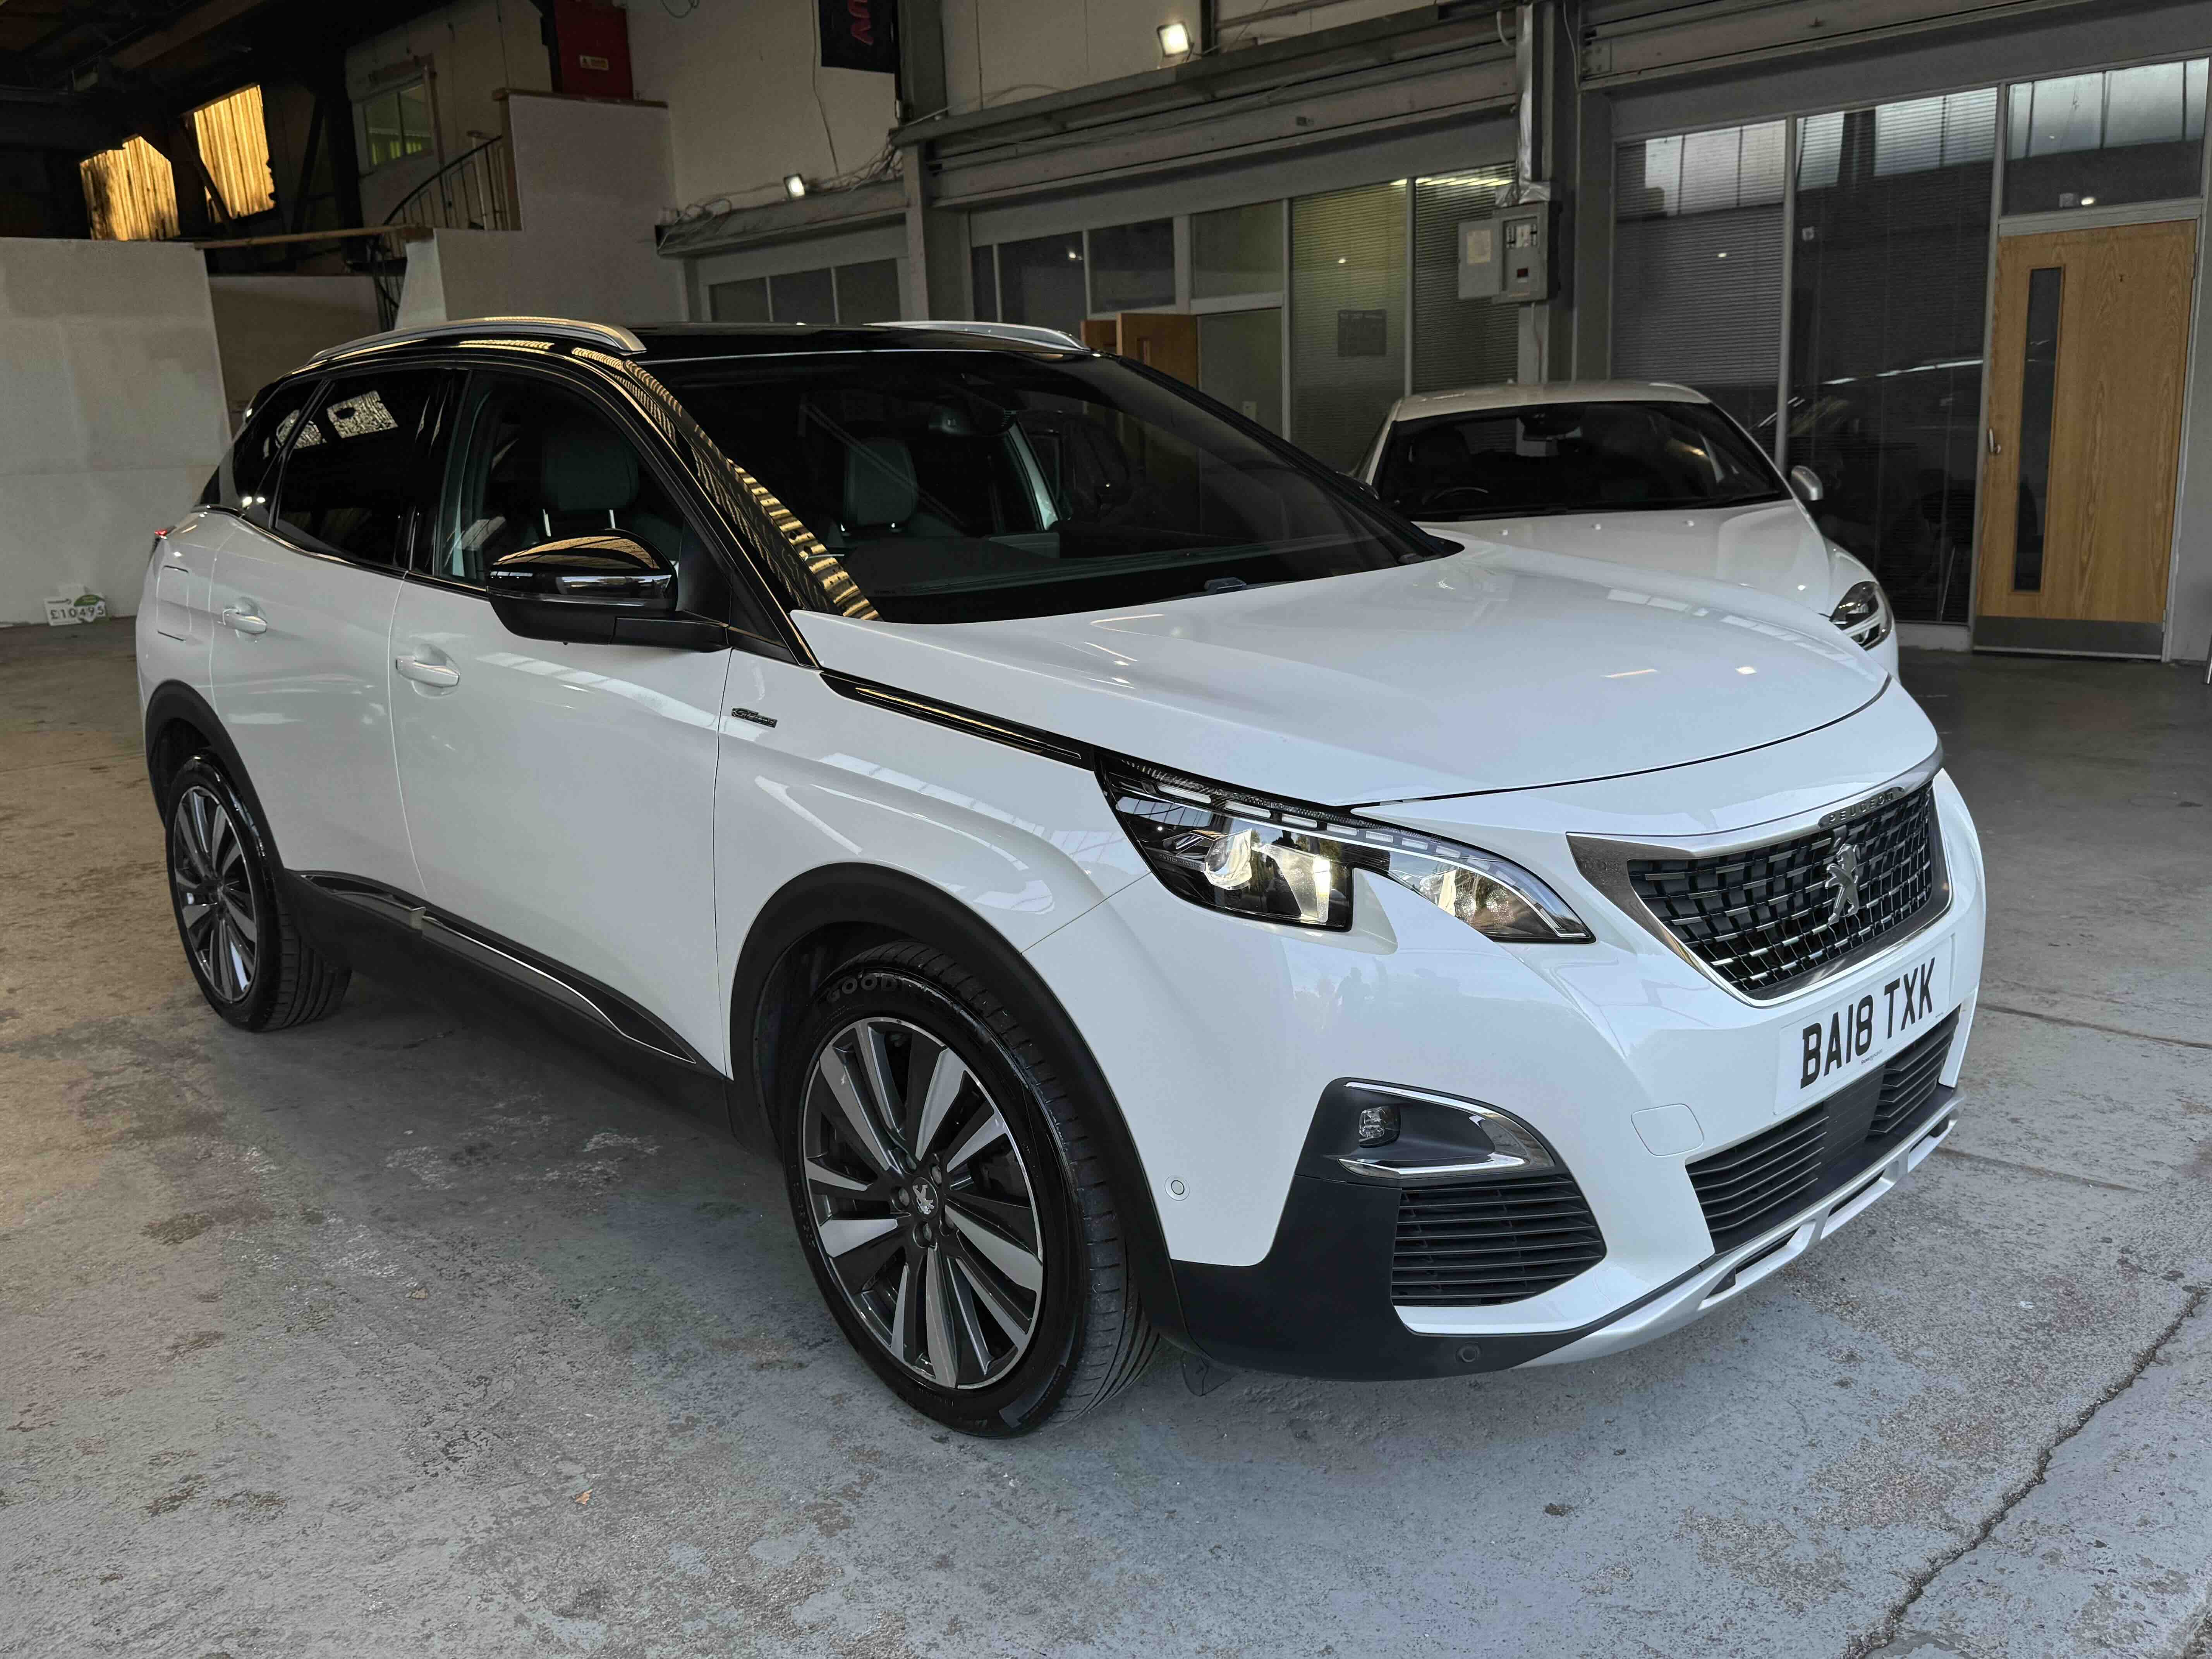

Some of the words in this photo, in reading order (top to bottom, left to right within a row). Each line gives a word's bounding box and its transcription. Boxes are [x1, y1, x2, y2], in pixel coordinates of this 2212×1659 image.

[1828, 791, 1893, 825] PEUGEOT
[1800, 994, 1874, 1090] BA18
[1884, 957, 1936, 1039] TXK
